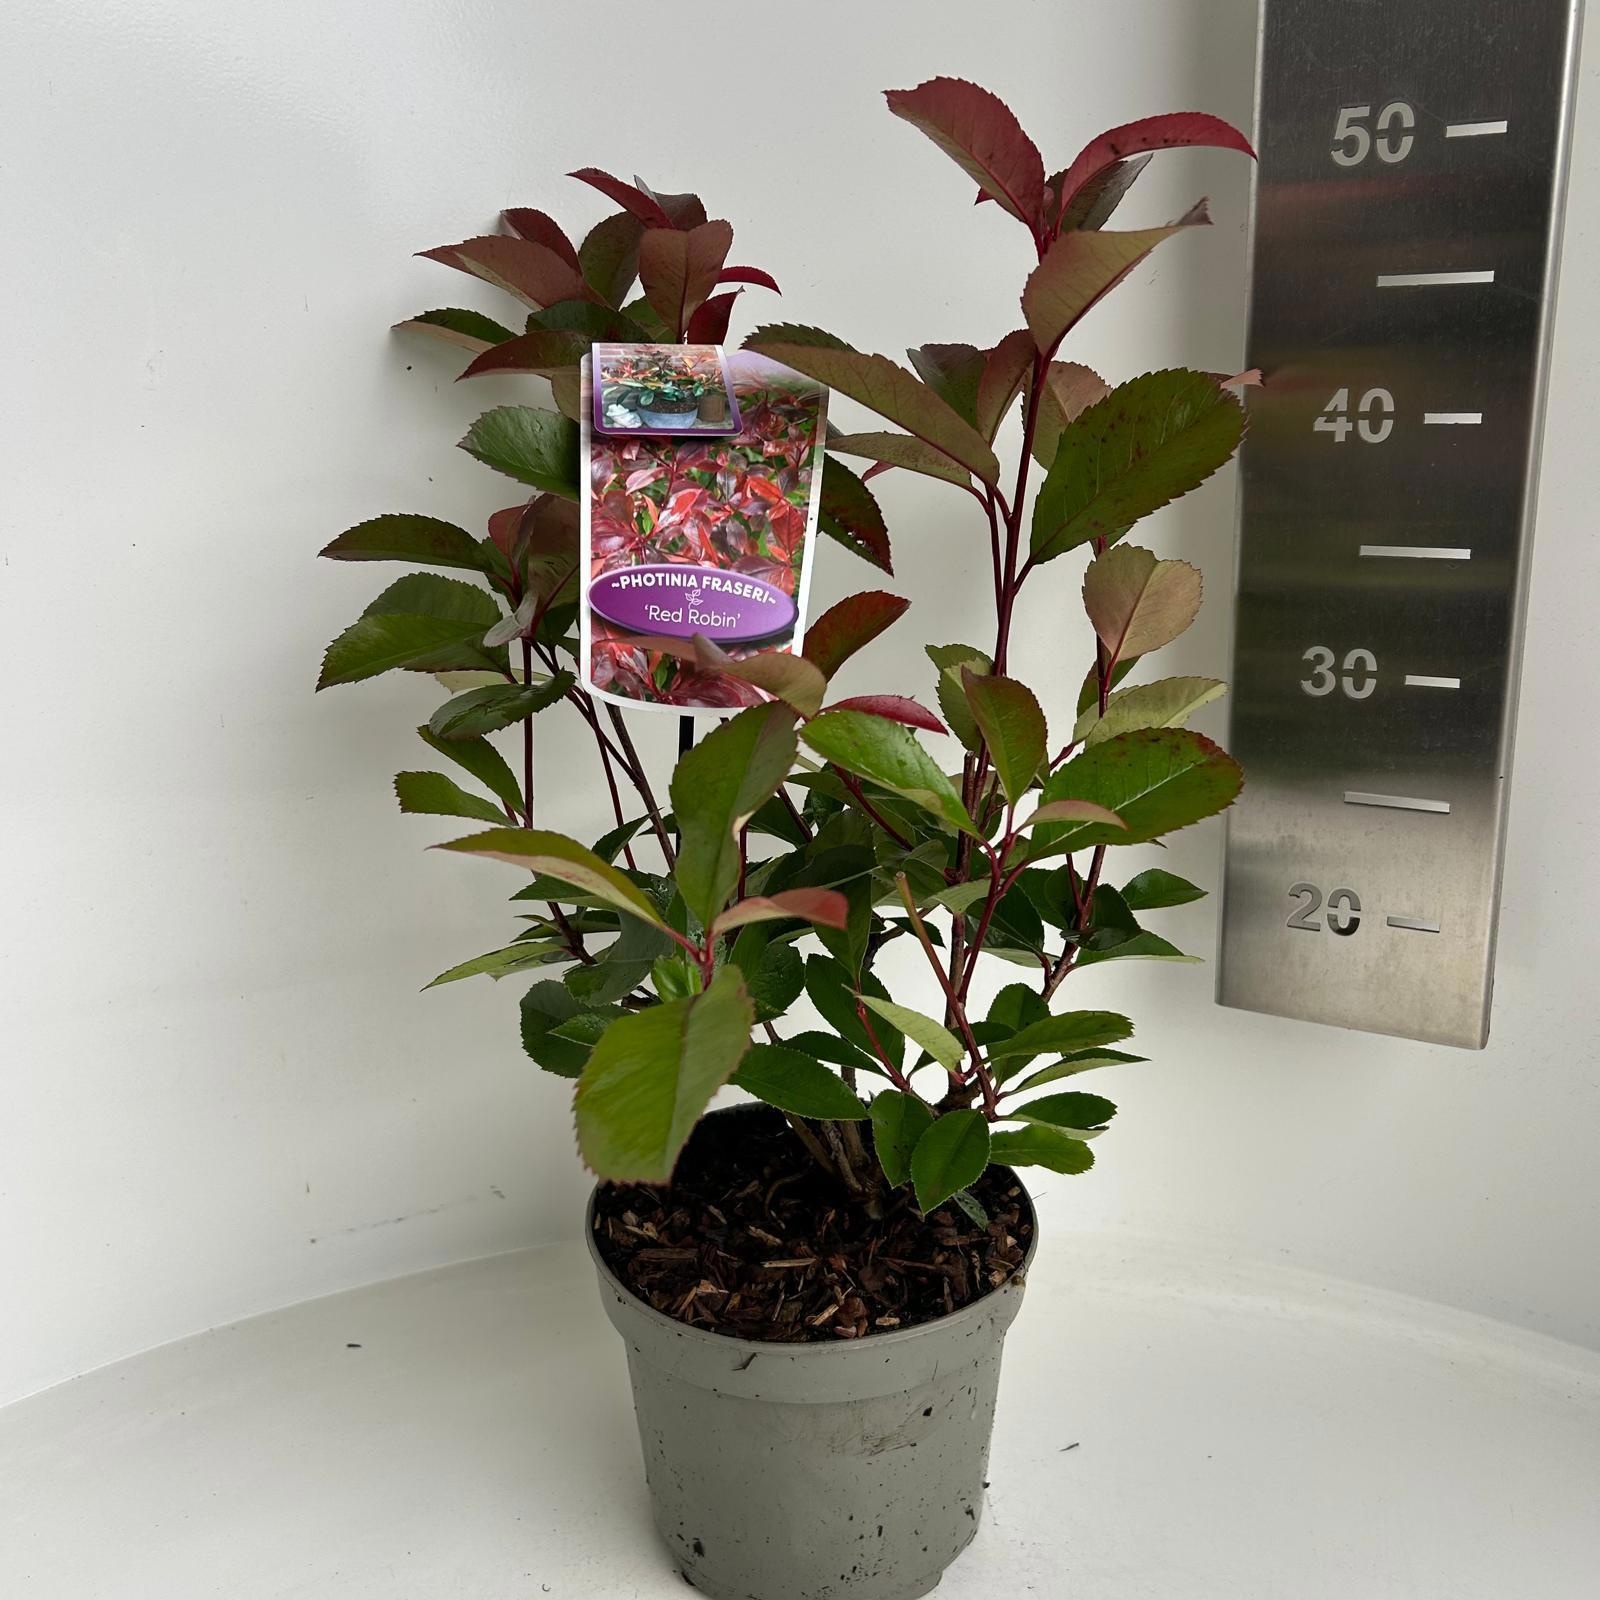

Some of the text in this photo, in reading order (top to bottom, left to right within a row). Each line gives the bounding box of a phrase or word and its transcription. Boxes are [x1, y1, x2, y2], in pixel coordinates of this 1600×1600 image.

[1330, 102, 1415, 167] 50
[1313, 387, 1396, 443] 40
[1300, 647, 1378, 700] 30
[1287, 882, 1362, 937] 20
